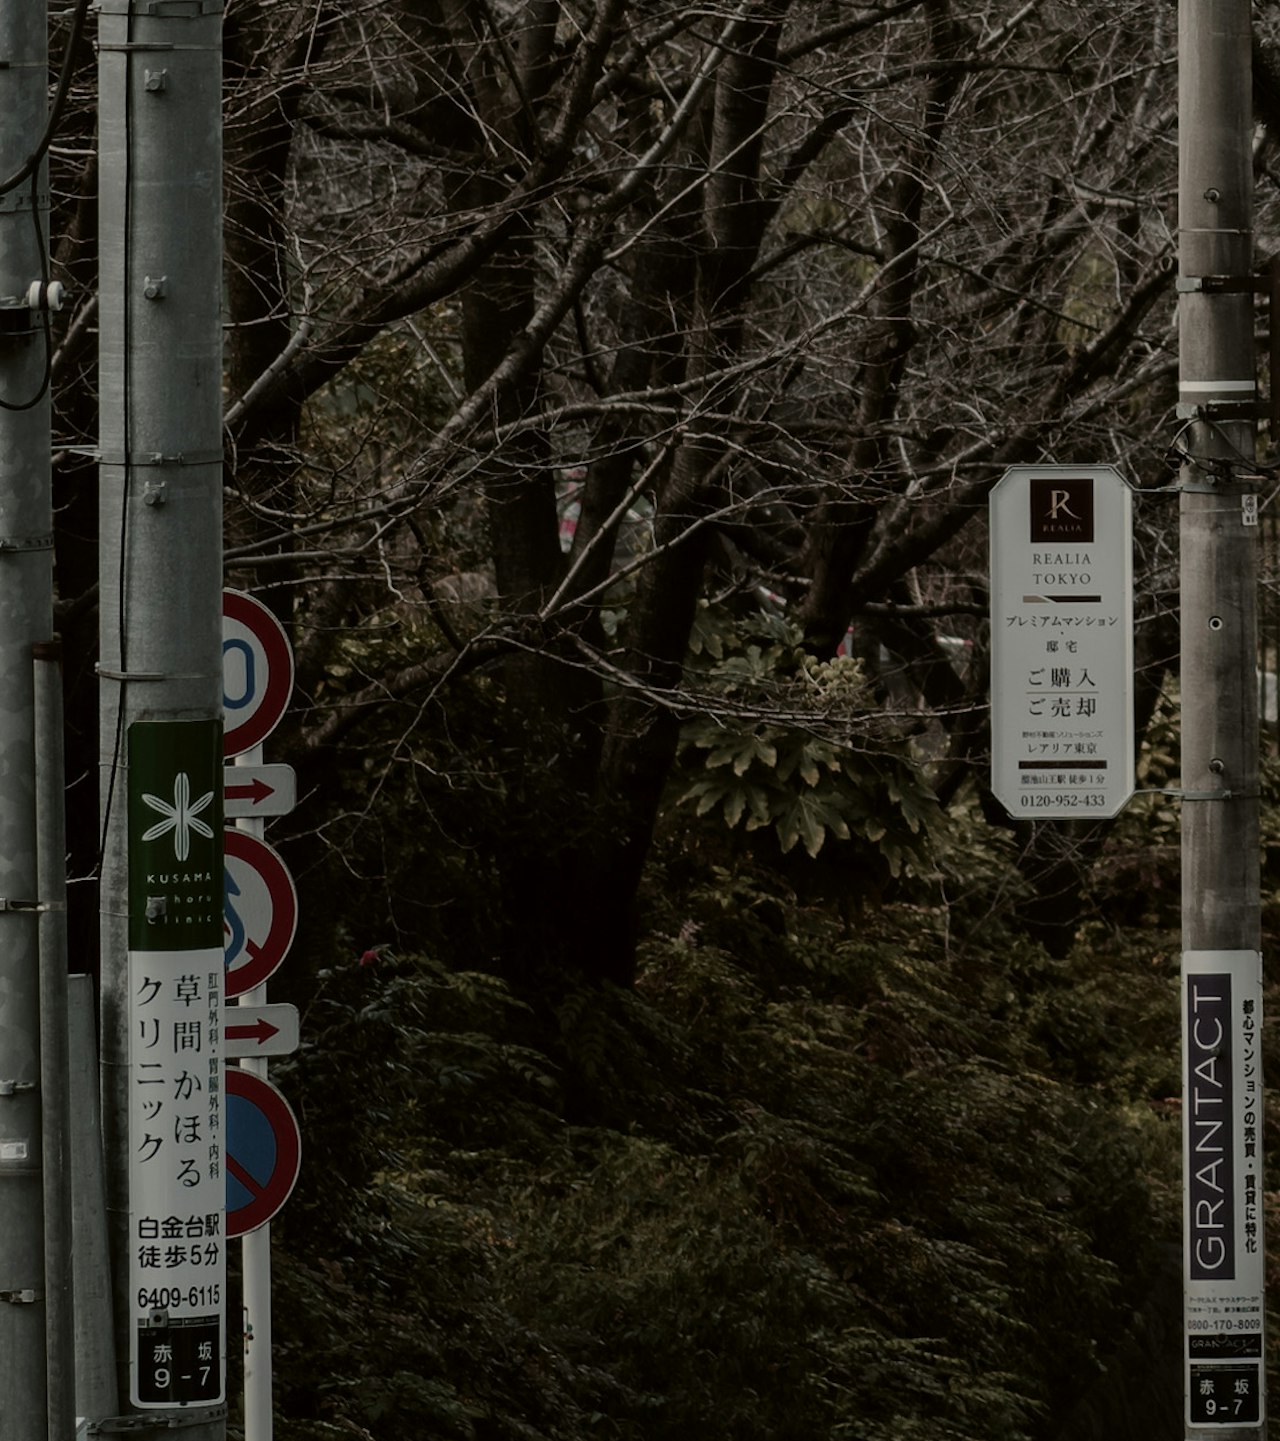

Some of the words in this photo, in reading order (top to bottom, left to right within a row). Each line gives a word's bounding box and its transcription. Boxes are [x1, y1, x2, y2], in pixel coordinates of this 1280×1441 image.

[1042, 523, 1083, 533] REALIA
[1033, 553, 1092, 565] REALIA
[1033, 573, 1092, 585] TOKYO
[1006, 615, 1119, 627] プレミアムマンション
[1028, 667, 1097, 688] ご購入
[1029, 697, 1097, 717] ご売却
[1027, 742, 1098, 755] レアリア東京
[1021, 794, 1106, 808] 0120-952-433
[146, 872, 212, 884] KUSAMA
[137, 976, 165, 1164] クリニック
[172, 974, 202, 1188] 草間かほる
[1193, 984, 1226, 1270] GRANTACT
[138, 1213, 220, 1239] 白金台駅
[138, 1243, 219, 1269] 徒歩5分
[138, 1284, 220, 1308] 6409-6115
[153, 1340, 213, 1364] 赤坂
[154, 1366, 211, 1389] 9-7
[1199, 1378, 1249, 1396] 赤坂
[1205, 1399, 1243, 1416] 9-7
